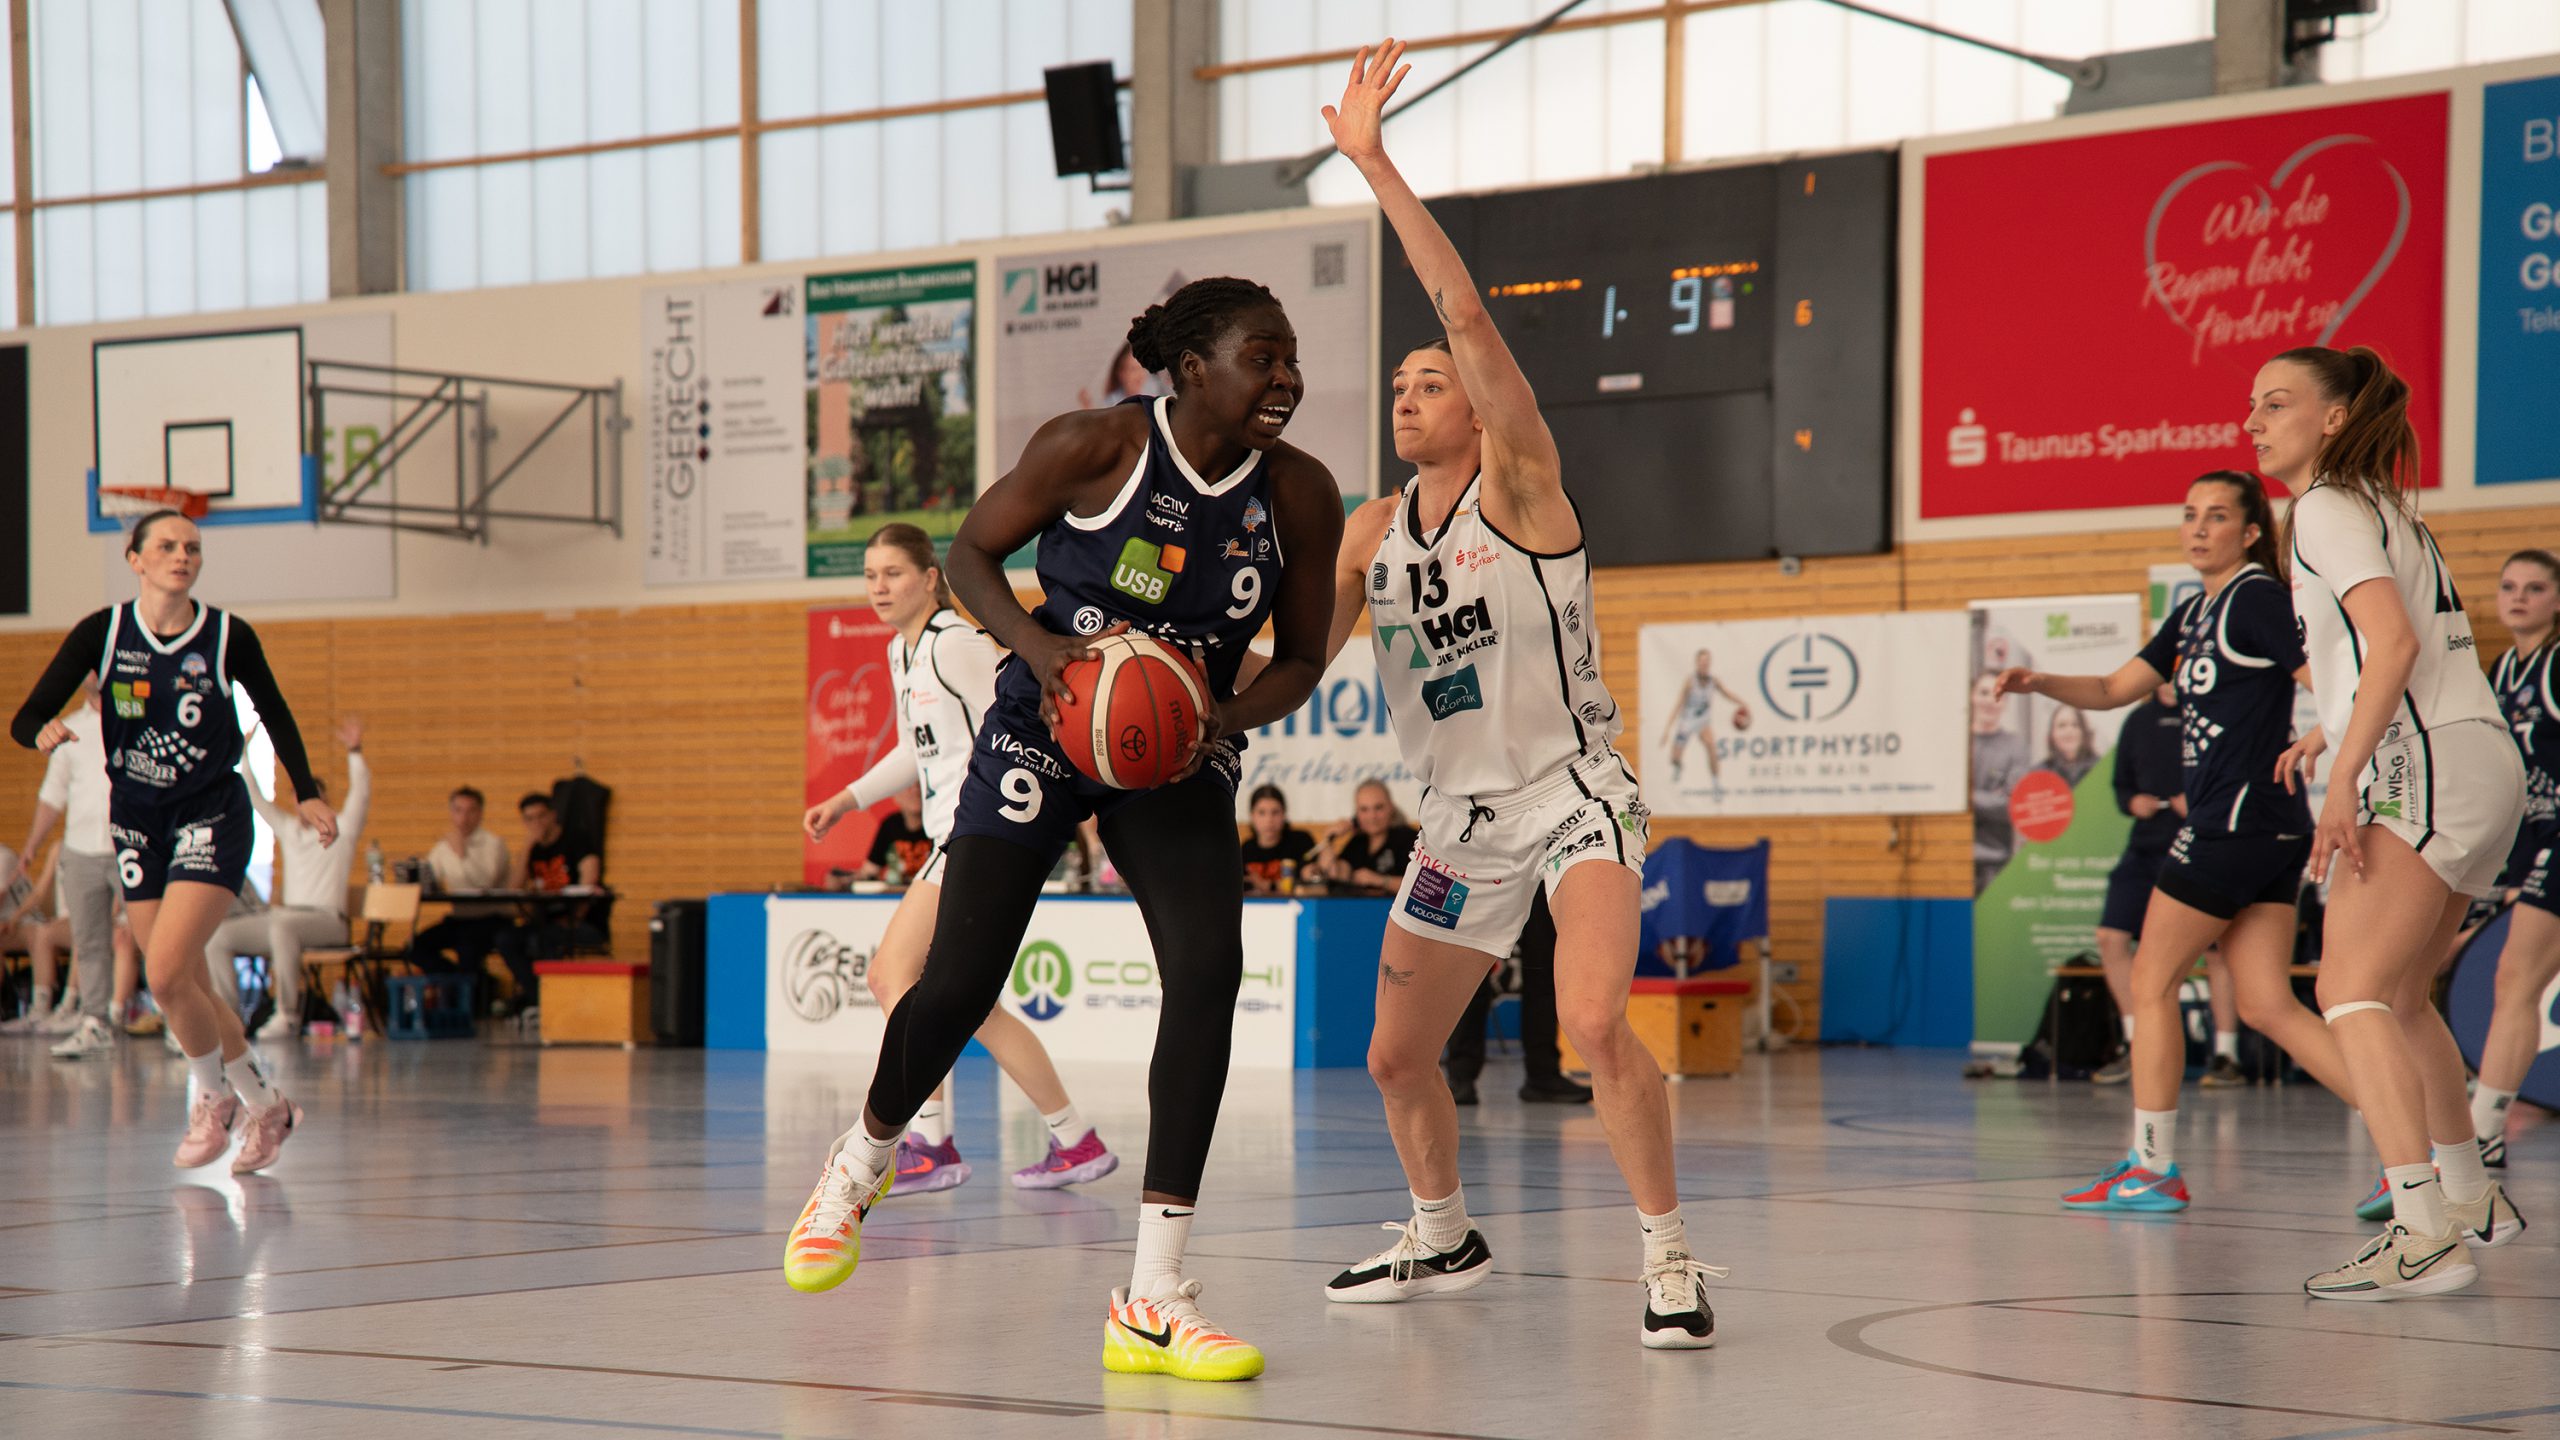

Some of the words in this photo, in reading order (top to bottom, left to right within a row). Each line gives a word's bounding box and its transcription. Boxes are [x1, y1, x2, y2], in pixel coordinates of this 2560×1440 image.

[1045, 261, 1098, 296] HGI
[1670, 276, 1702, 335] 9
[665, 295, 695, 500] GERECHT
[1998, 431, 2095, 463] Taunus
[2100, 418, 2240, 462] Sparkasse
[1114, 562, 1164, 601] USB
[1225, 566, 1262, 620] 9
[1405, 559, 1449, 615] 13
[1421, 596, 1493, 651] HGI
[2177, 656, 2217, 695] 49
[177, 691, 203, 728] 6
[1716, 731, 1902, 761] SPORTPHYSIO
[2514, 721, 2535, 755] 7
[998, 767, 1043, 823] 9
[2388, 754, 2406, 800] WISG
[117, 848, 144, 889] 6
[1418, 876, 1445, 895] Women's
[1421, 869, 1442, 884] Global
[1415, 881, 1436, 897] Health
[1411, 904, 1448, 924] HOLOGIC
